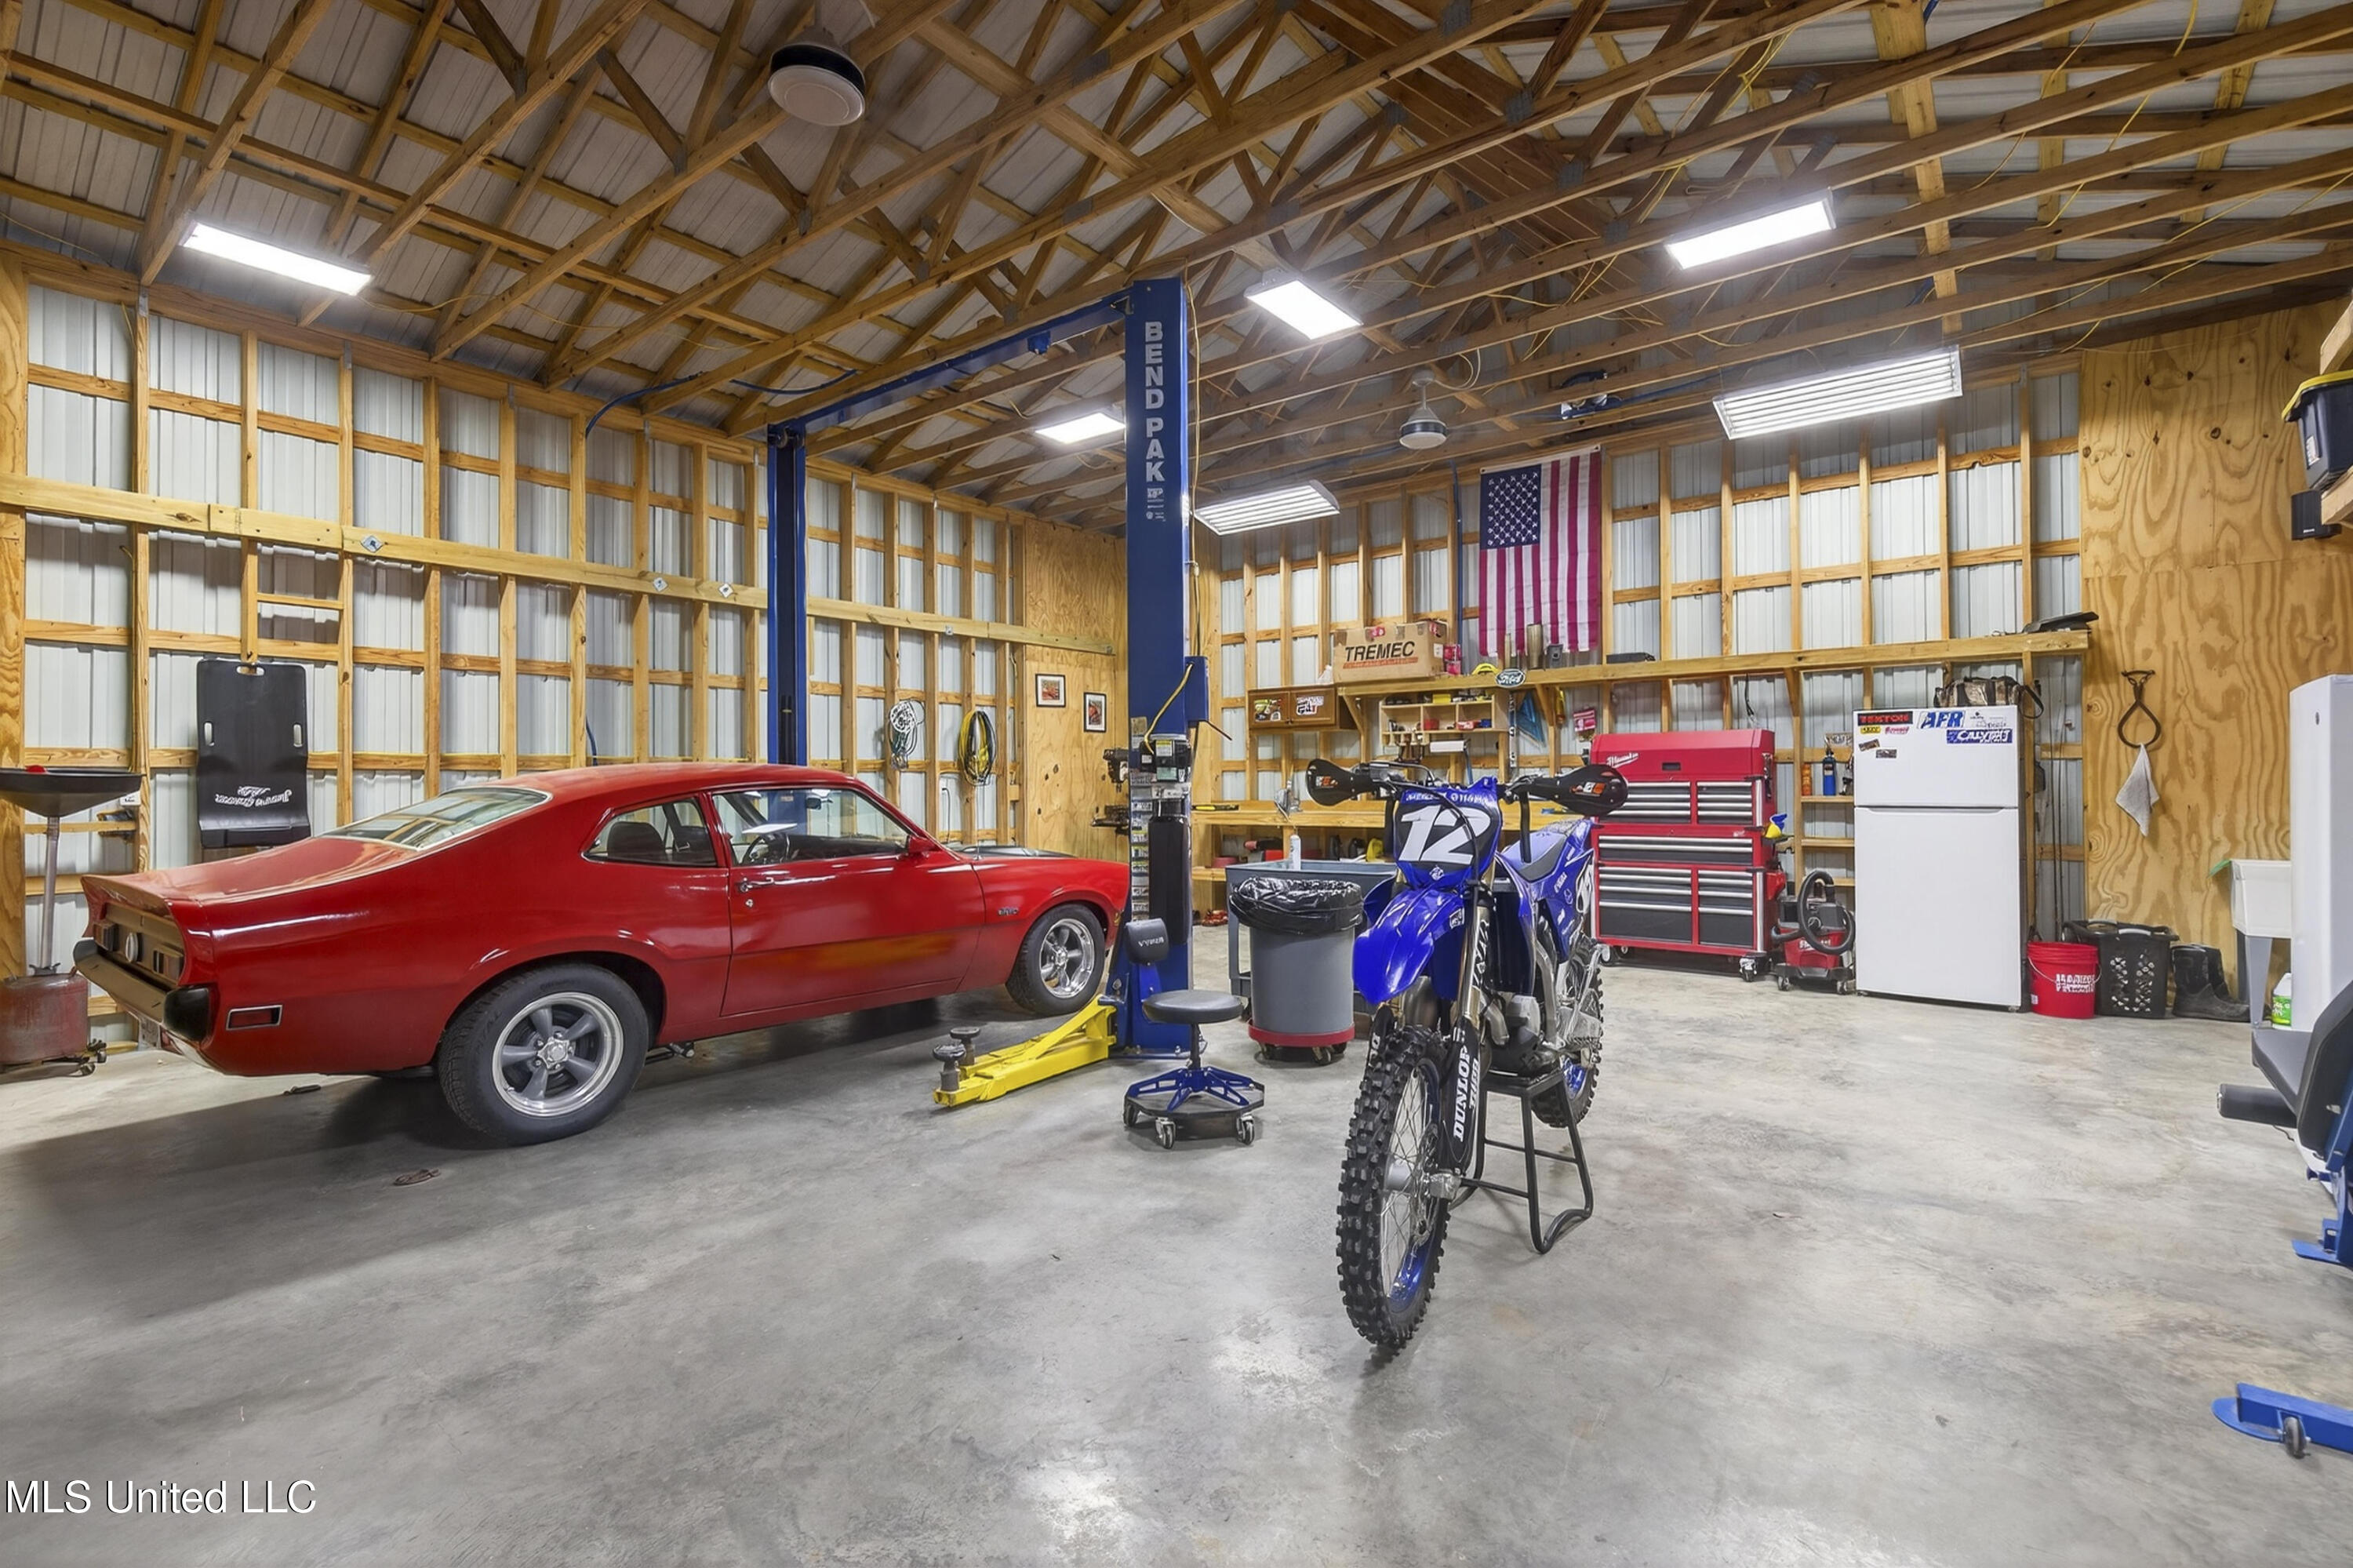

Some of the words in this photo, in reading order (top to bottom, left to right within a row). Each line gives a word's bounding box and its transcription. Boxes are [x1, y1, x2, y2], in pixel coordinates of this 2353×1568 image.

[1145, 322, 1164, 409] BEND
[1145, 417, 1166, 482] PAK
[1344, 641, 1416, 662] TREMEC
[1921, 711, 1964, 729] AFR
[1398, 804, 1491, 865] 12
[1453, 1045, 1471, 1143] DUNLOP
